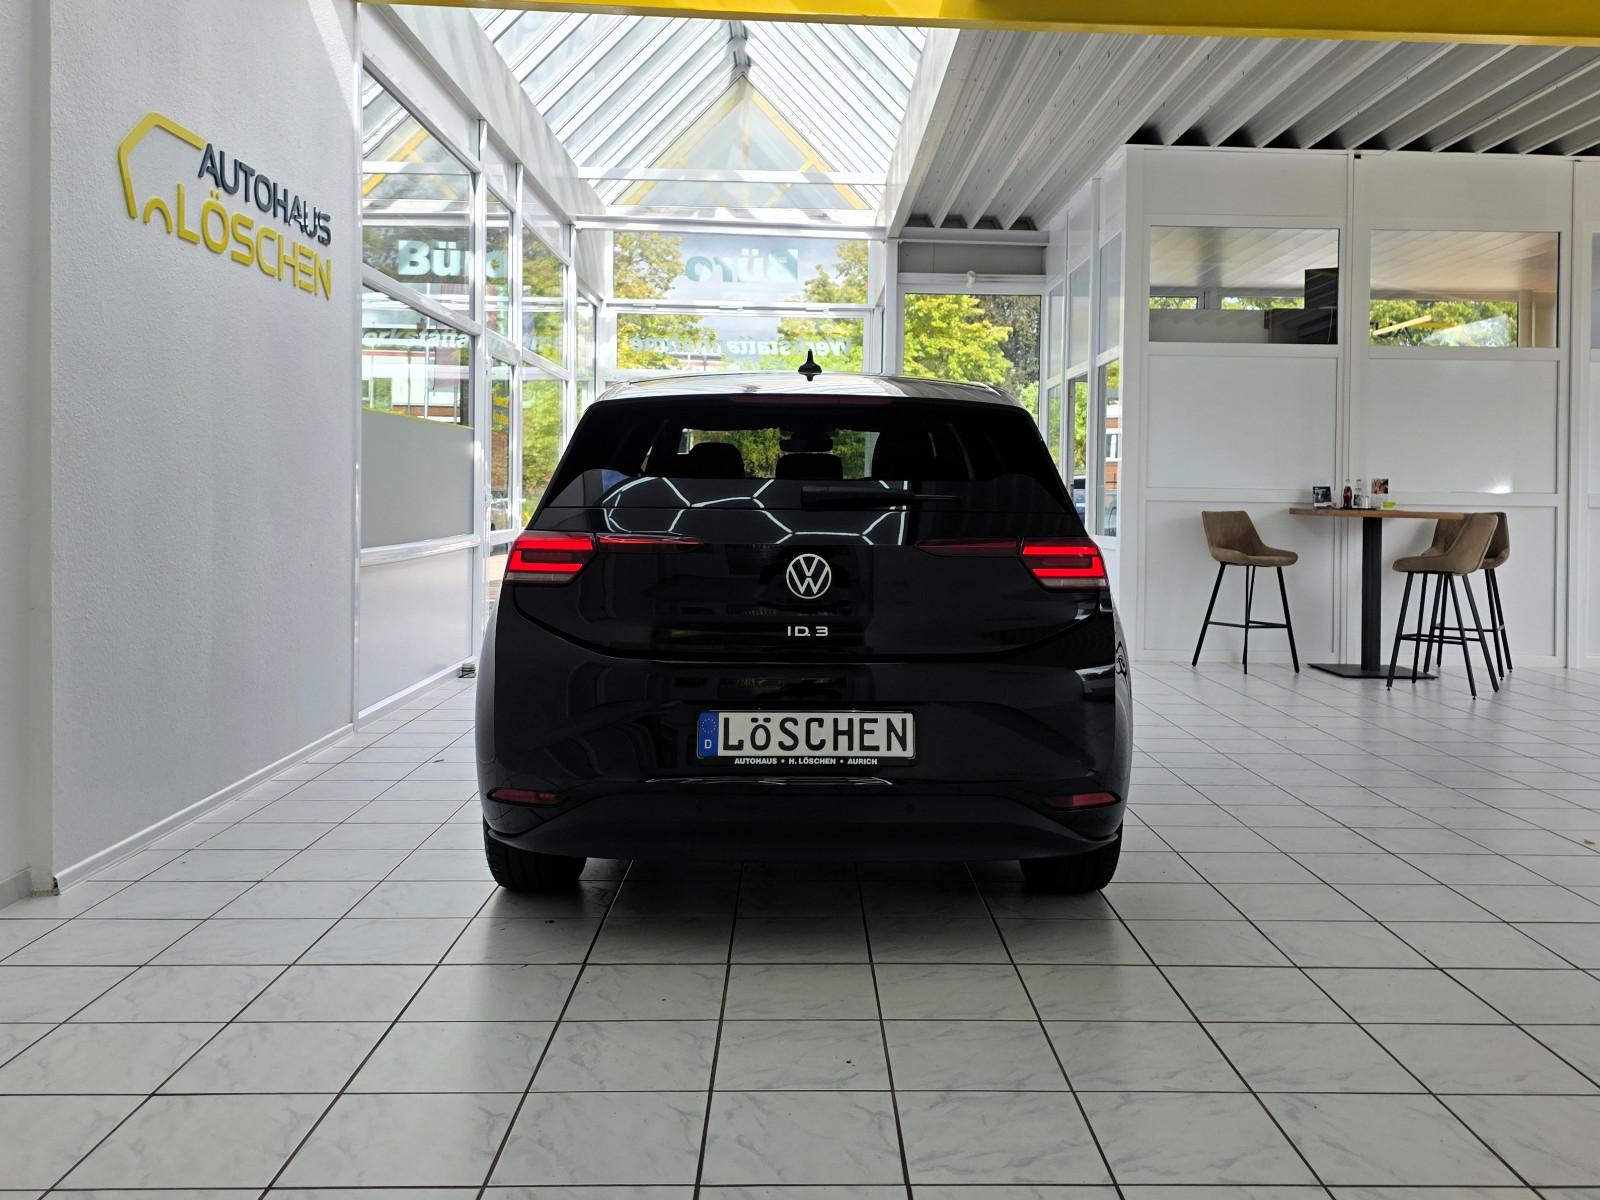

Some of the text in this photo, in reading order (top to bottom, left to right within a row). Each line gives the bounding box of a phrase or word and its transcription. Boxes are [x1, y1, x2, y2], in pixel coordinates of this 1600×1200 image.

[198, 143, 331, 246] AUTOHAUS
[177, 183, 332, 301] LÖSCHEN
[398, 239, 508, 278] Büo
[787, 554, 831, 598] VW
[704, 739, 712, 749] D
[722, 717, 907, 752] LÖSCHEN
[734, 756, 878, 765] AUTOHAUS H. LÖSCHEN AURICH
